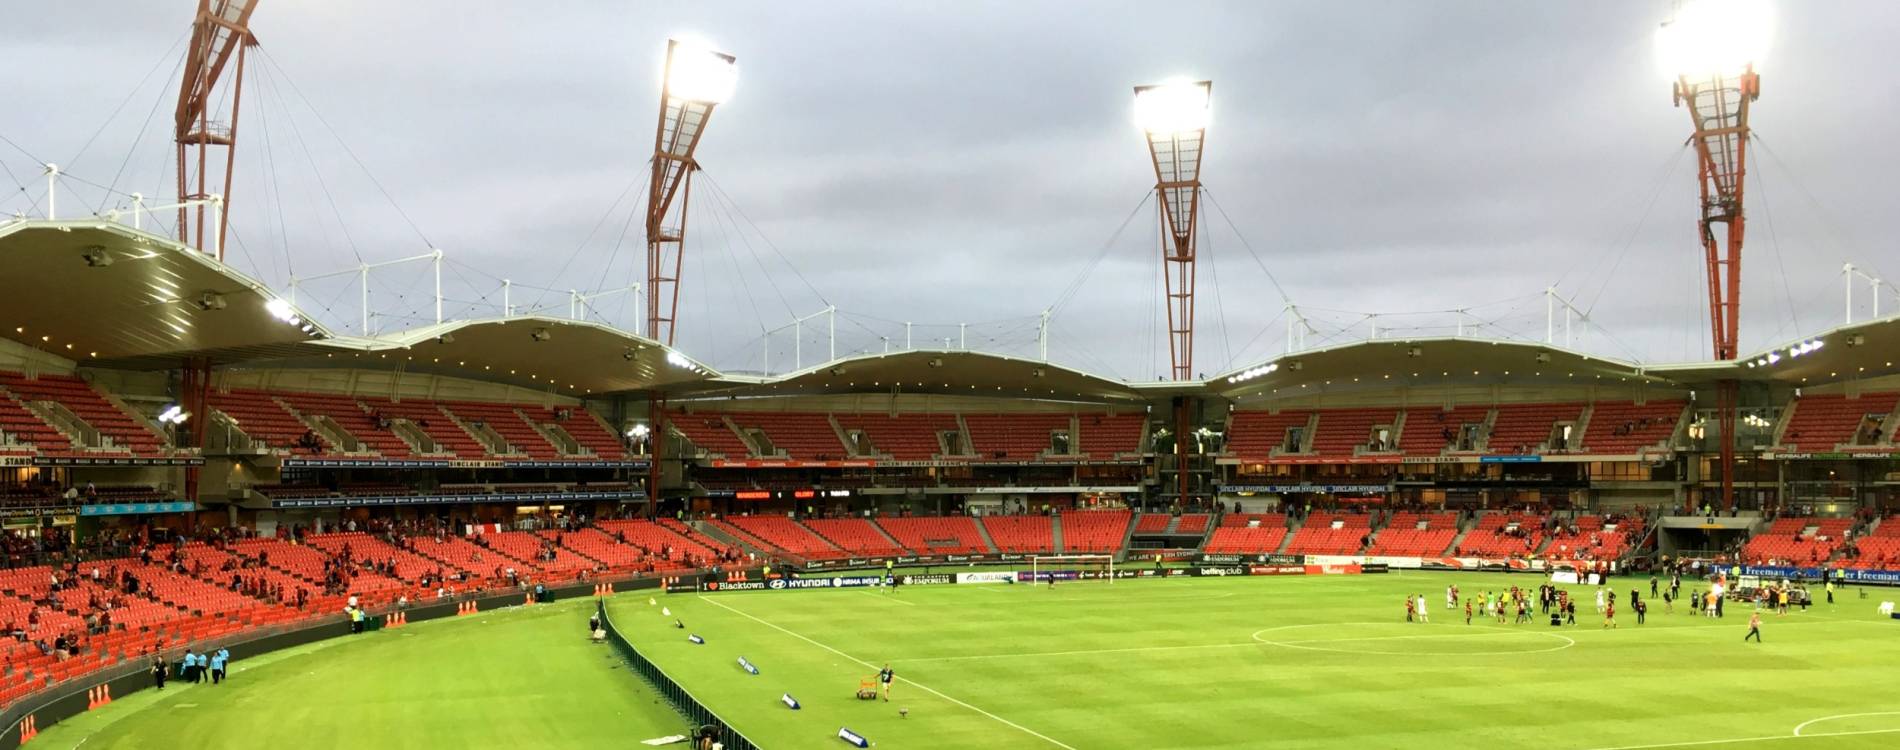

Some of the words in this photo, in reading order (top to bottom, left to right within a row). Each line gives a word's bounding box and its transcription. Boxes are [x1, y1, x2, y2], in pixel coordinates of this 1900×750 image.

[1201, 566, 1242, 576] betting.club
[1746, 566, 1784, 575] Freeman
[1829, 571, 1855, 579] urer
[1858, 570, 1899, 580] Freeman
[719, 581, 764, 590] Blacktown
[789, 579, 830, 587] HYUNDAI
